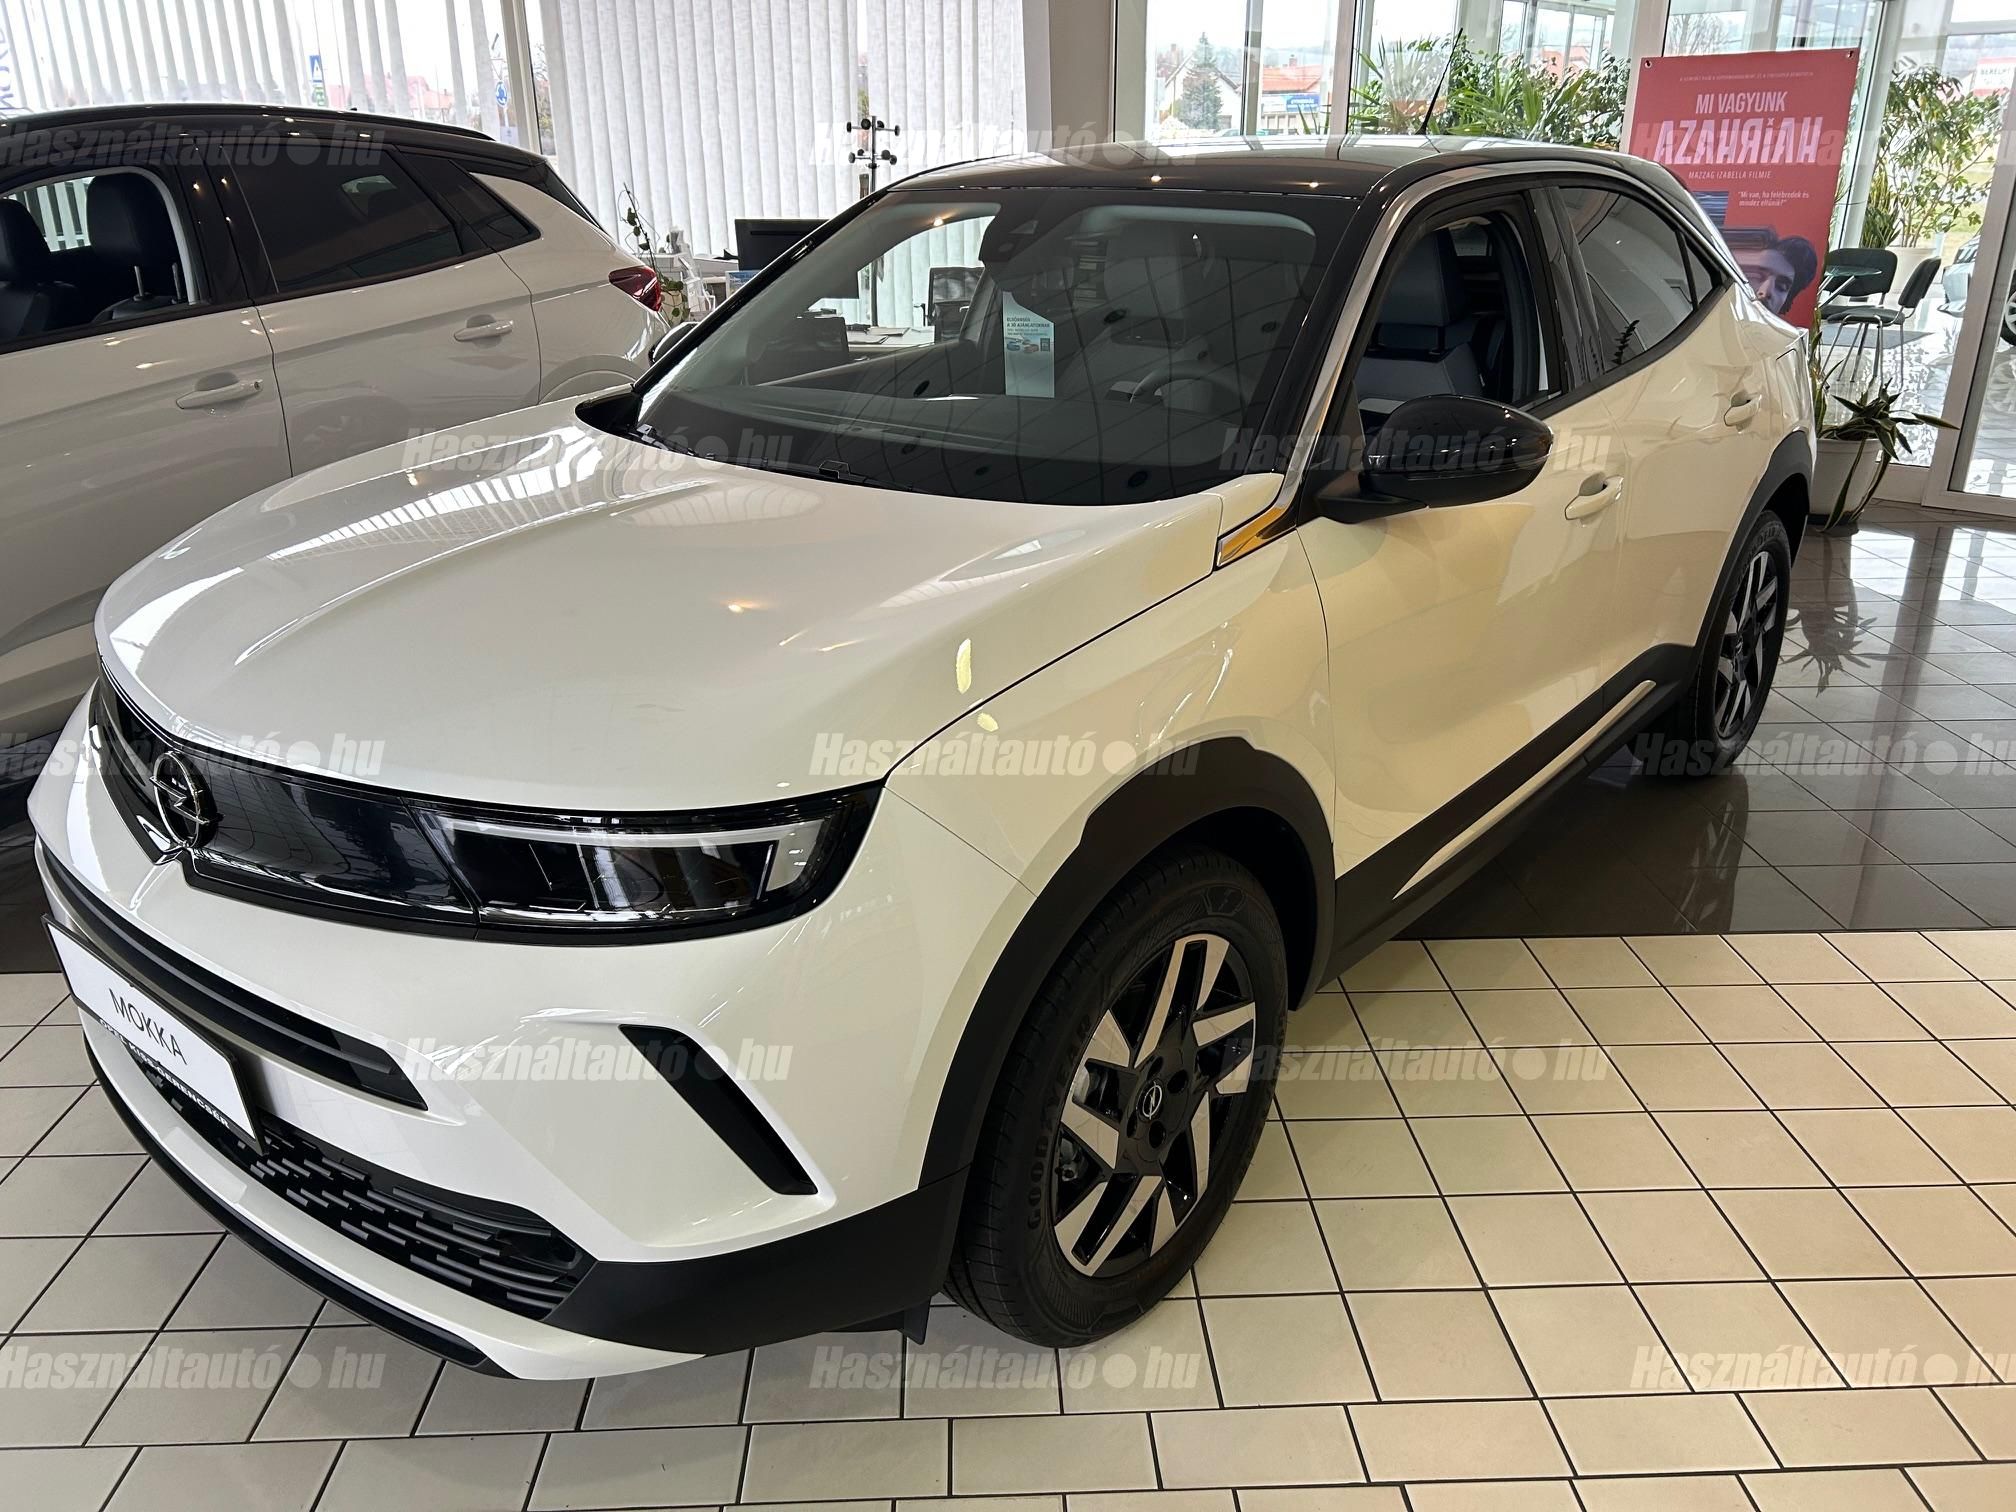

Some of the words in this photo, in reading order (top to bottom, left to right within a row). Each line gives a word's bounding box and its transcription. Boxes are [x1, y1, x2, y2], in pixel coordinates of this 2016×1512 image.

[1695, 94, 1714, 114] MI
[1718, 91, 1787, 113] VAGYUNK
[99, 1018, 128, 1045] OPEL
[109, 987, 187, 1066] MOKKA
